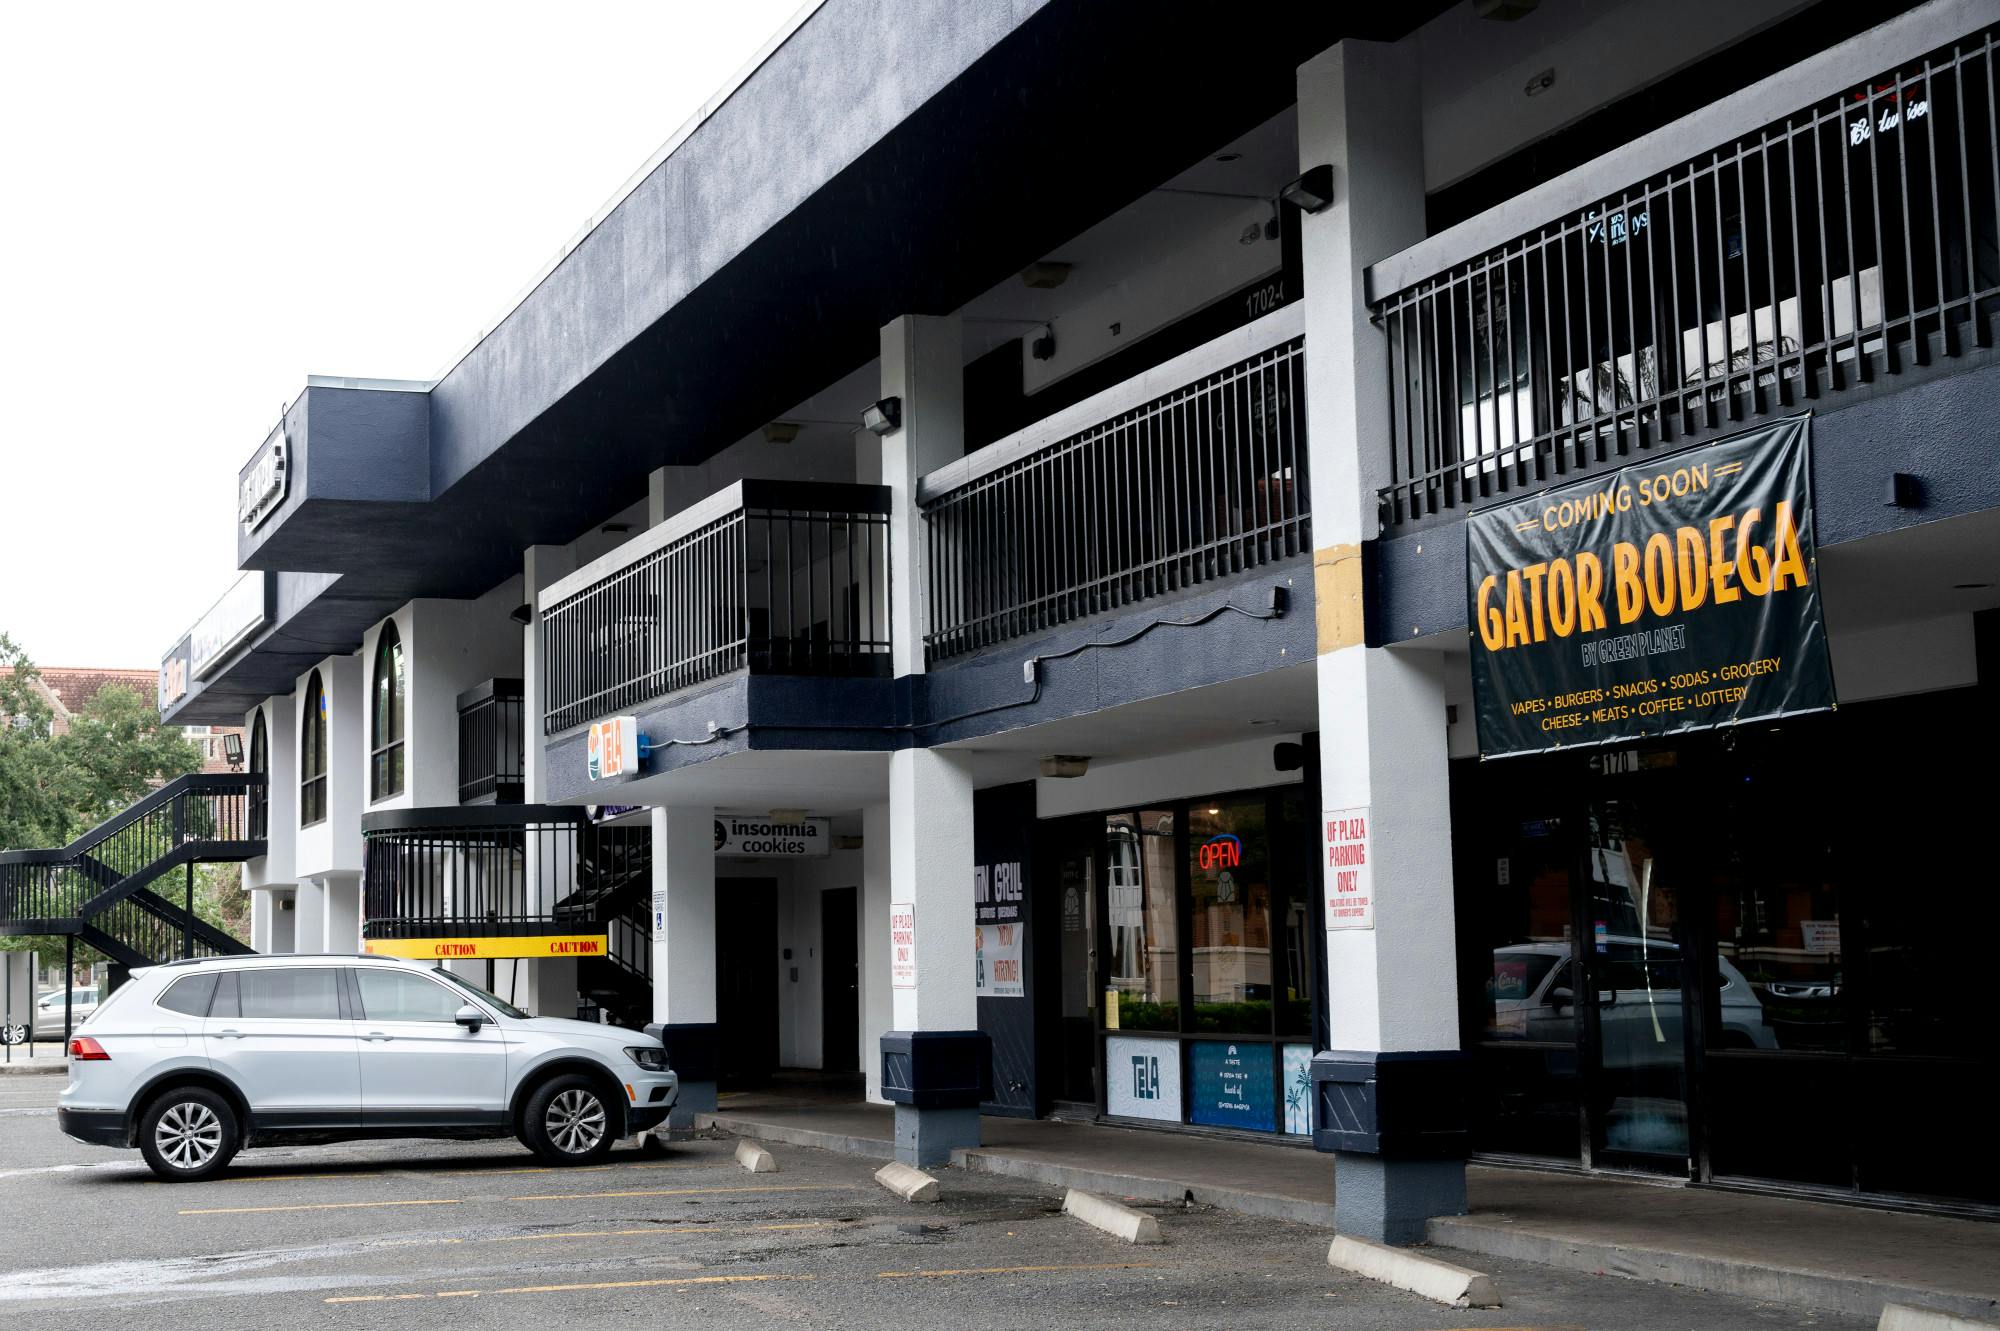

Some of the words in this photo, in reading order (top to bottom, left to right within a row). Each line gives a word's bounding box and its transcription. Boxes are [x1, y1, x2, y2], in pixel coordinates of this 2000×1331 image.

[1543, 485, 1632, 533] COMING
[1639, 463, 1709, 506] SOON
[1477, 552, 1607, 652] GATOR
[1613, 501, 1809, 625] BODEGA
[1581, 641, 1598, 668] BY
[1598, 634, 1638, 664] GREEN
[1638, 624, 1685, 657] PLANET
[1511, 698, 1546, 716] VAPES
[1554, 688, 1603, 709] BURGERS
[1612, 679, 1658, 699] SNACKS
[1670, 671, 1709, 690] SODAS
[1720, 657, 1781, 681] GROCERY
[1541, 712, 1583, 732] CHEESE
[1592, 705, 1629, 723] MEATS
[1638, 696, 1685, 716] COFFEE
[1695, 685, 1749, 708] LOTTERY
[601, 719, 623, 777] TELA
[732, 820, 817, 837] insomnia
[1327, 821, 1337, 842] UF
[1339, 818, 1366, 841] PLAZA
[742, 838, 805, 853] cookies
[1199, 841, 1239, 870] OPEN
[1329, 843, 1365, 867] PARKING
[974, 865, 989, 903] TIN
[994, 862, 1023, 903] GRILL
[1337, 870, 1358, 892] ONLY
[898, 914, 913, 929] PLAZA
[436, 944, 474, 956] CAUTION
[549, 942, 597, 953] CAUTION
[893, 931, 913, 945] PARKING
[897, 947, 909, 962] ONLY
[1132, 1055, 1160, 1100] TELA
